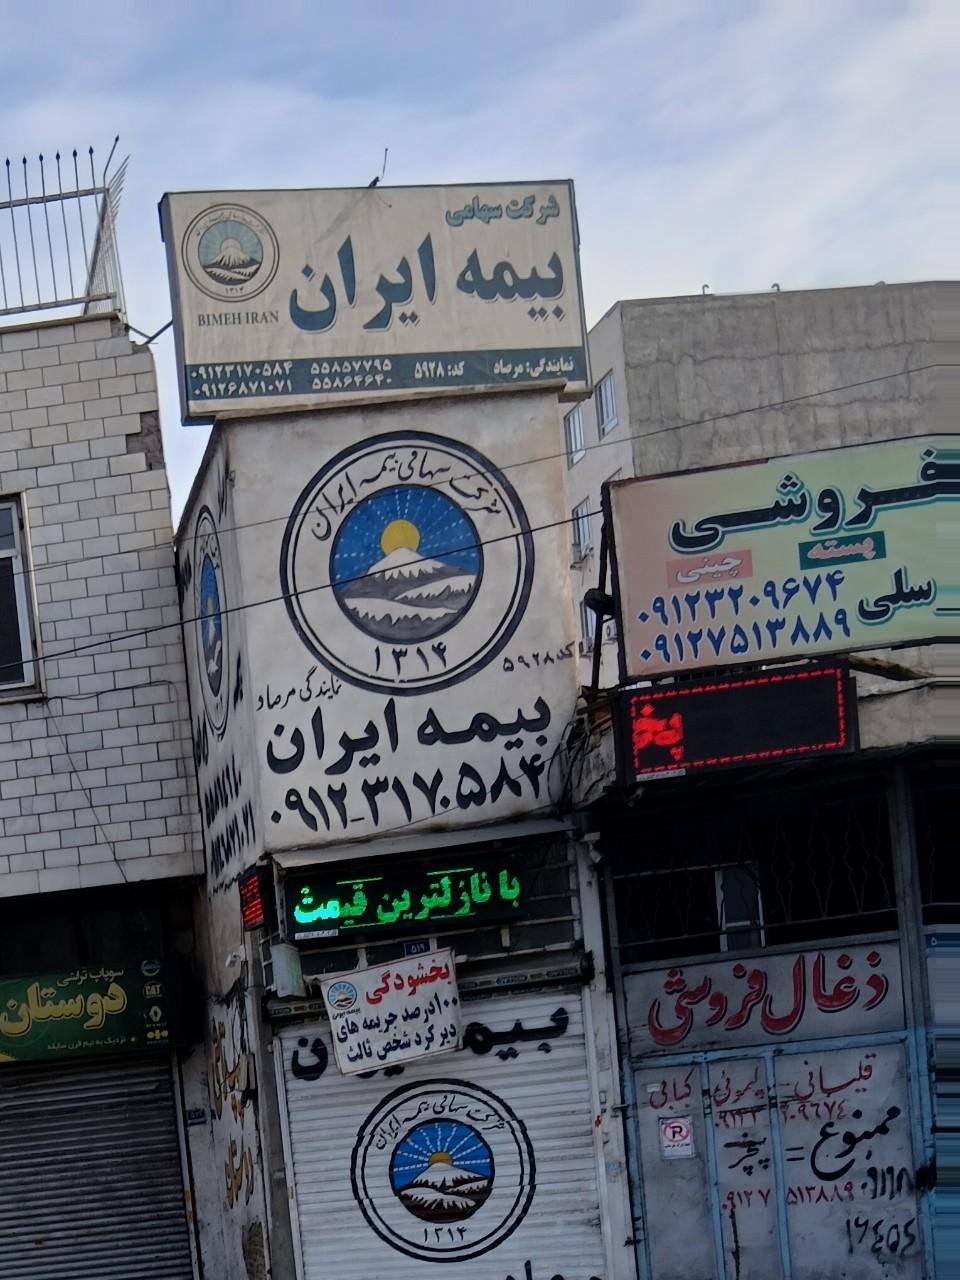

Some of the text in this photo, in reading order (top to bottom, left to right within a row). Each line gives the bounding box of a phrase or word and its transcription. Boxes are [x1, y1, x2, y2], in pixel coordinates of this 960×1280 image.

[446, 194, 560, 227] شرکت سهامی
[289, 232, 565, 332] بیمه ایران
[198, 310, 279, 326] BIMEH IRAN
[191, 360, 292, 380] ۰۹۱۲۳۱۷۰۵۸۴
[310, 358, 392, 375] ۵۵۸۵۷۷۹۵
[414, 361, 444, 380] ۵۹۲۸
[311, 472, 357, 541] ایران
[676, 554, 743, 585] چینی
[807, 537, 874, 561] پسته
[638, 568, 845, 625] ۰۹۱۲۳۲۰۹۶۷۴
[640, 607, 851, 663] ۰۹۱۲۷۵۱۳۸۸۹
[374, 642, 447, 675] ۱۳۱۴
[266, 697, 399, 775] ایران
[417, 696, 551, 751] بیمه
[366, 962, 451, 1005] بخشودگی
[647, 951, 889, 1046] ذغال فروشی
[0, 981, 128, 1037] دوستان
